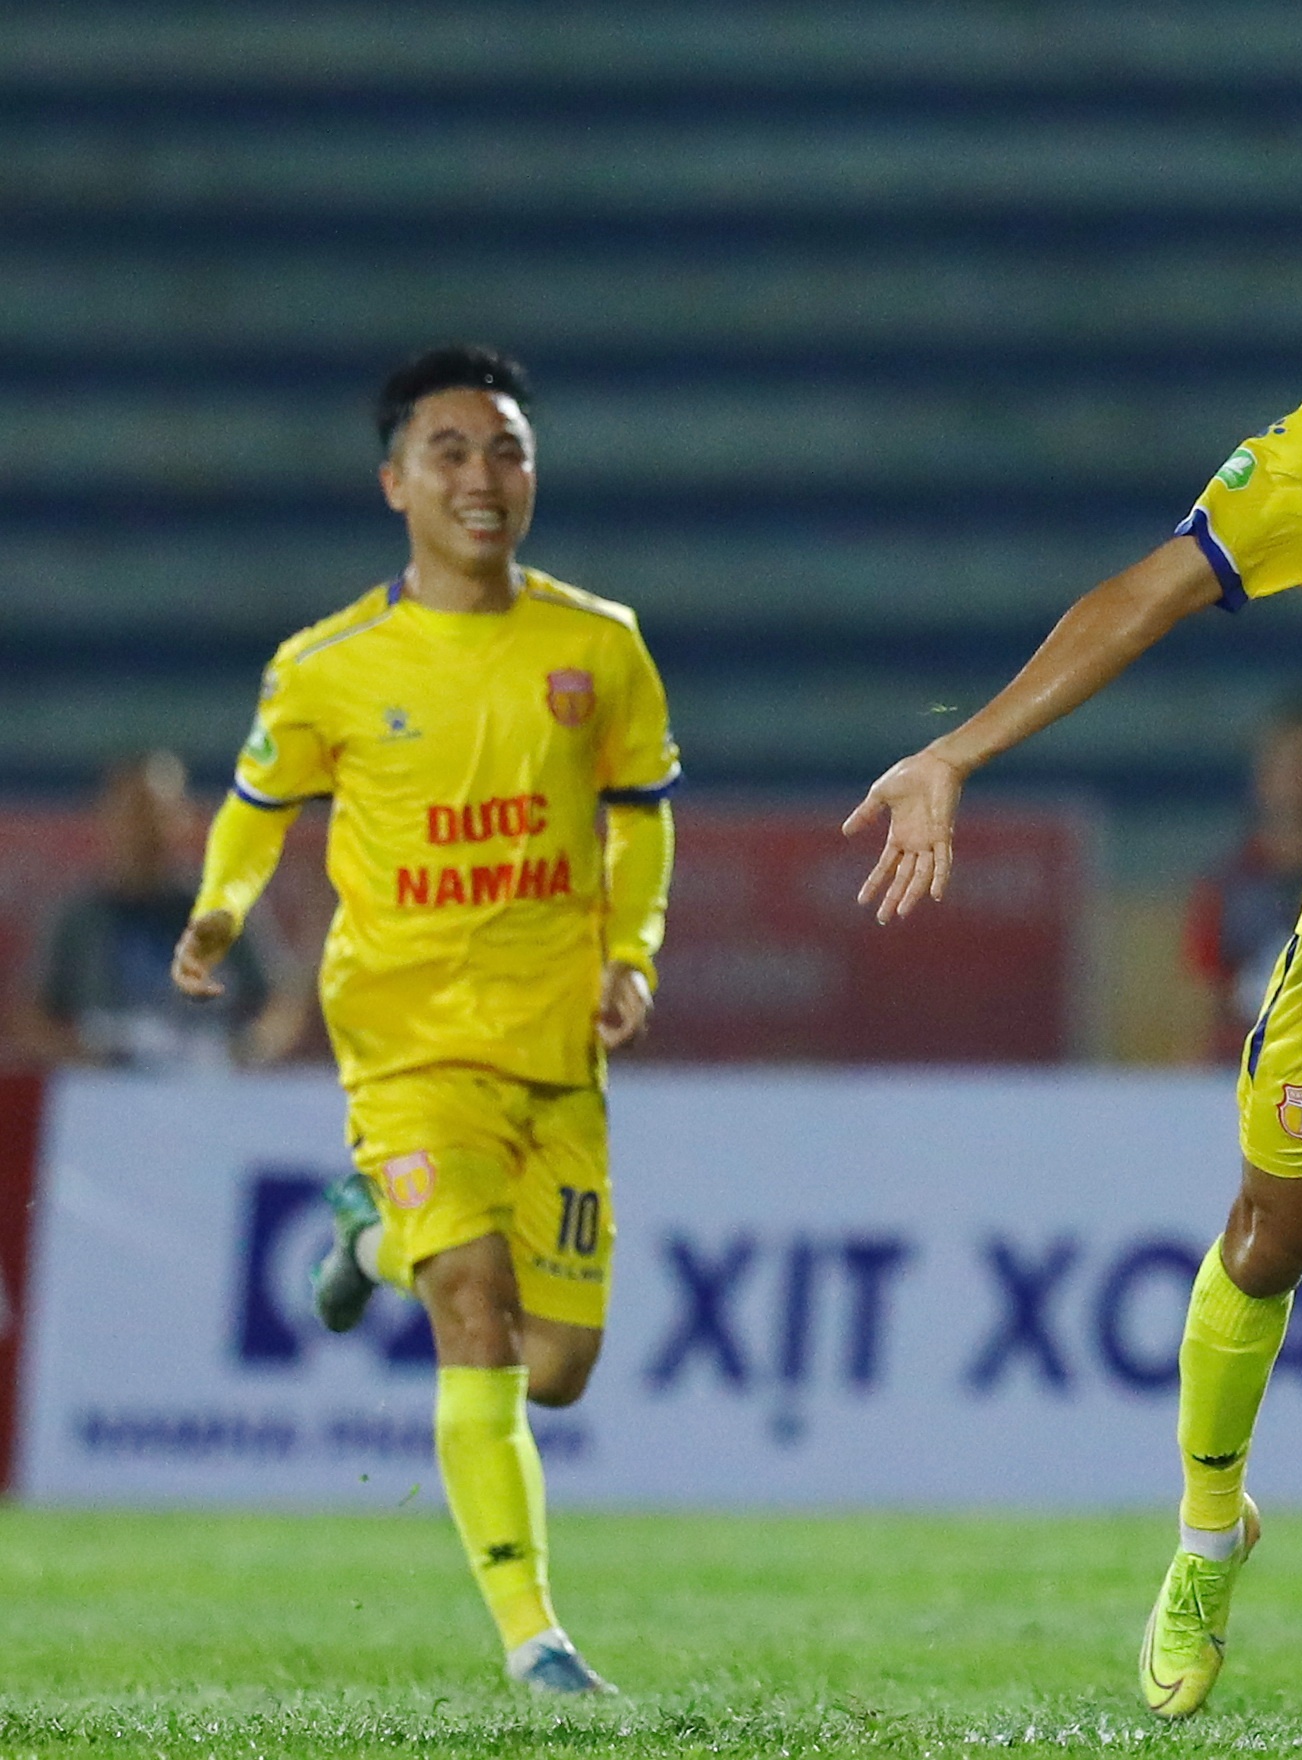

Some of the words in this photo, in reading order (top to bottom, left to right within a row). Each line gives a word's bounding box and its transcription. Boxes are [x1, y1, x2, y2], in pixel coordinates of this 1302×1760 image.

[397, 862, 516, 908] NAM
[558, 1187, 599, 1256] 10
[645, 1233, 914, 1444] XỊT
